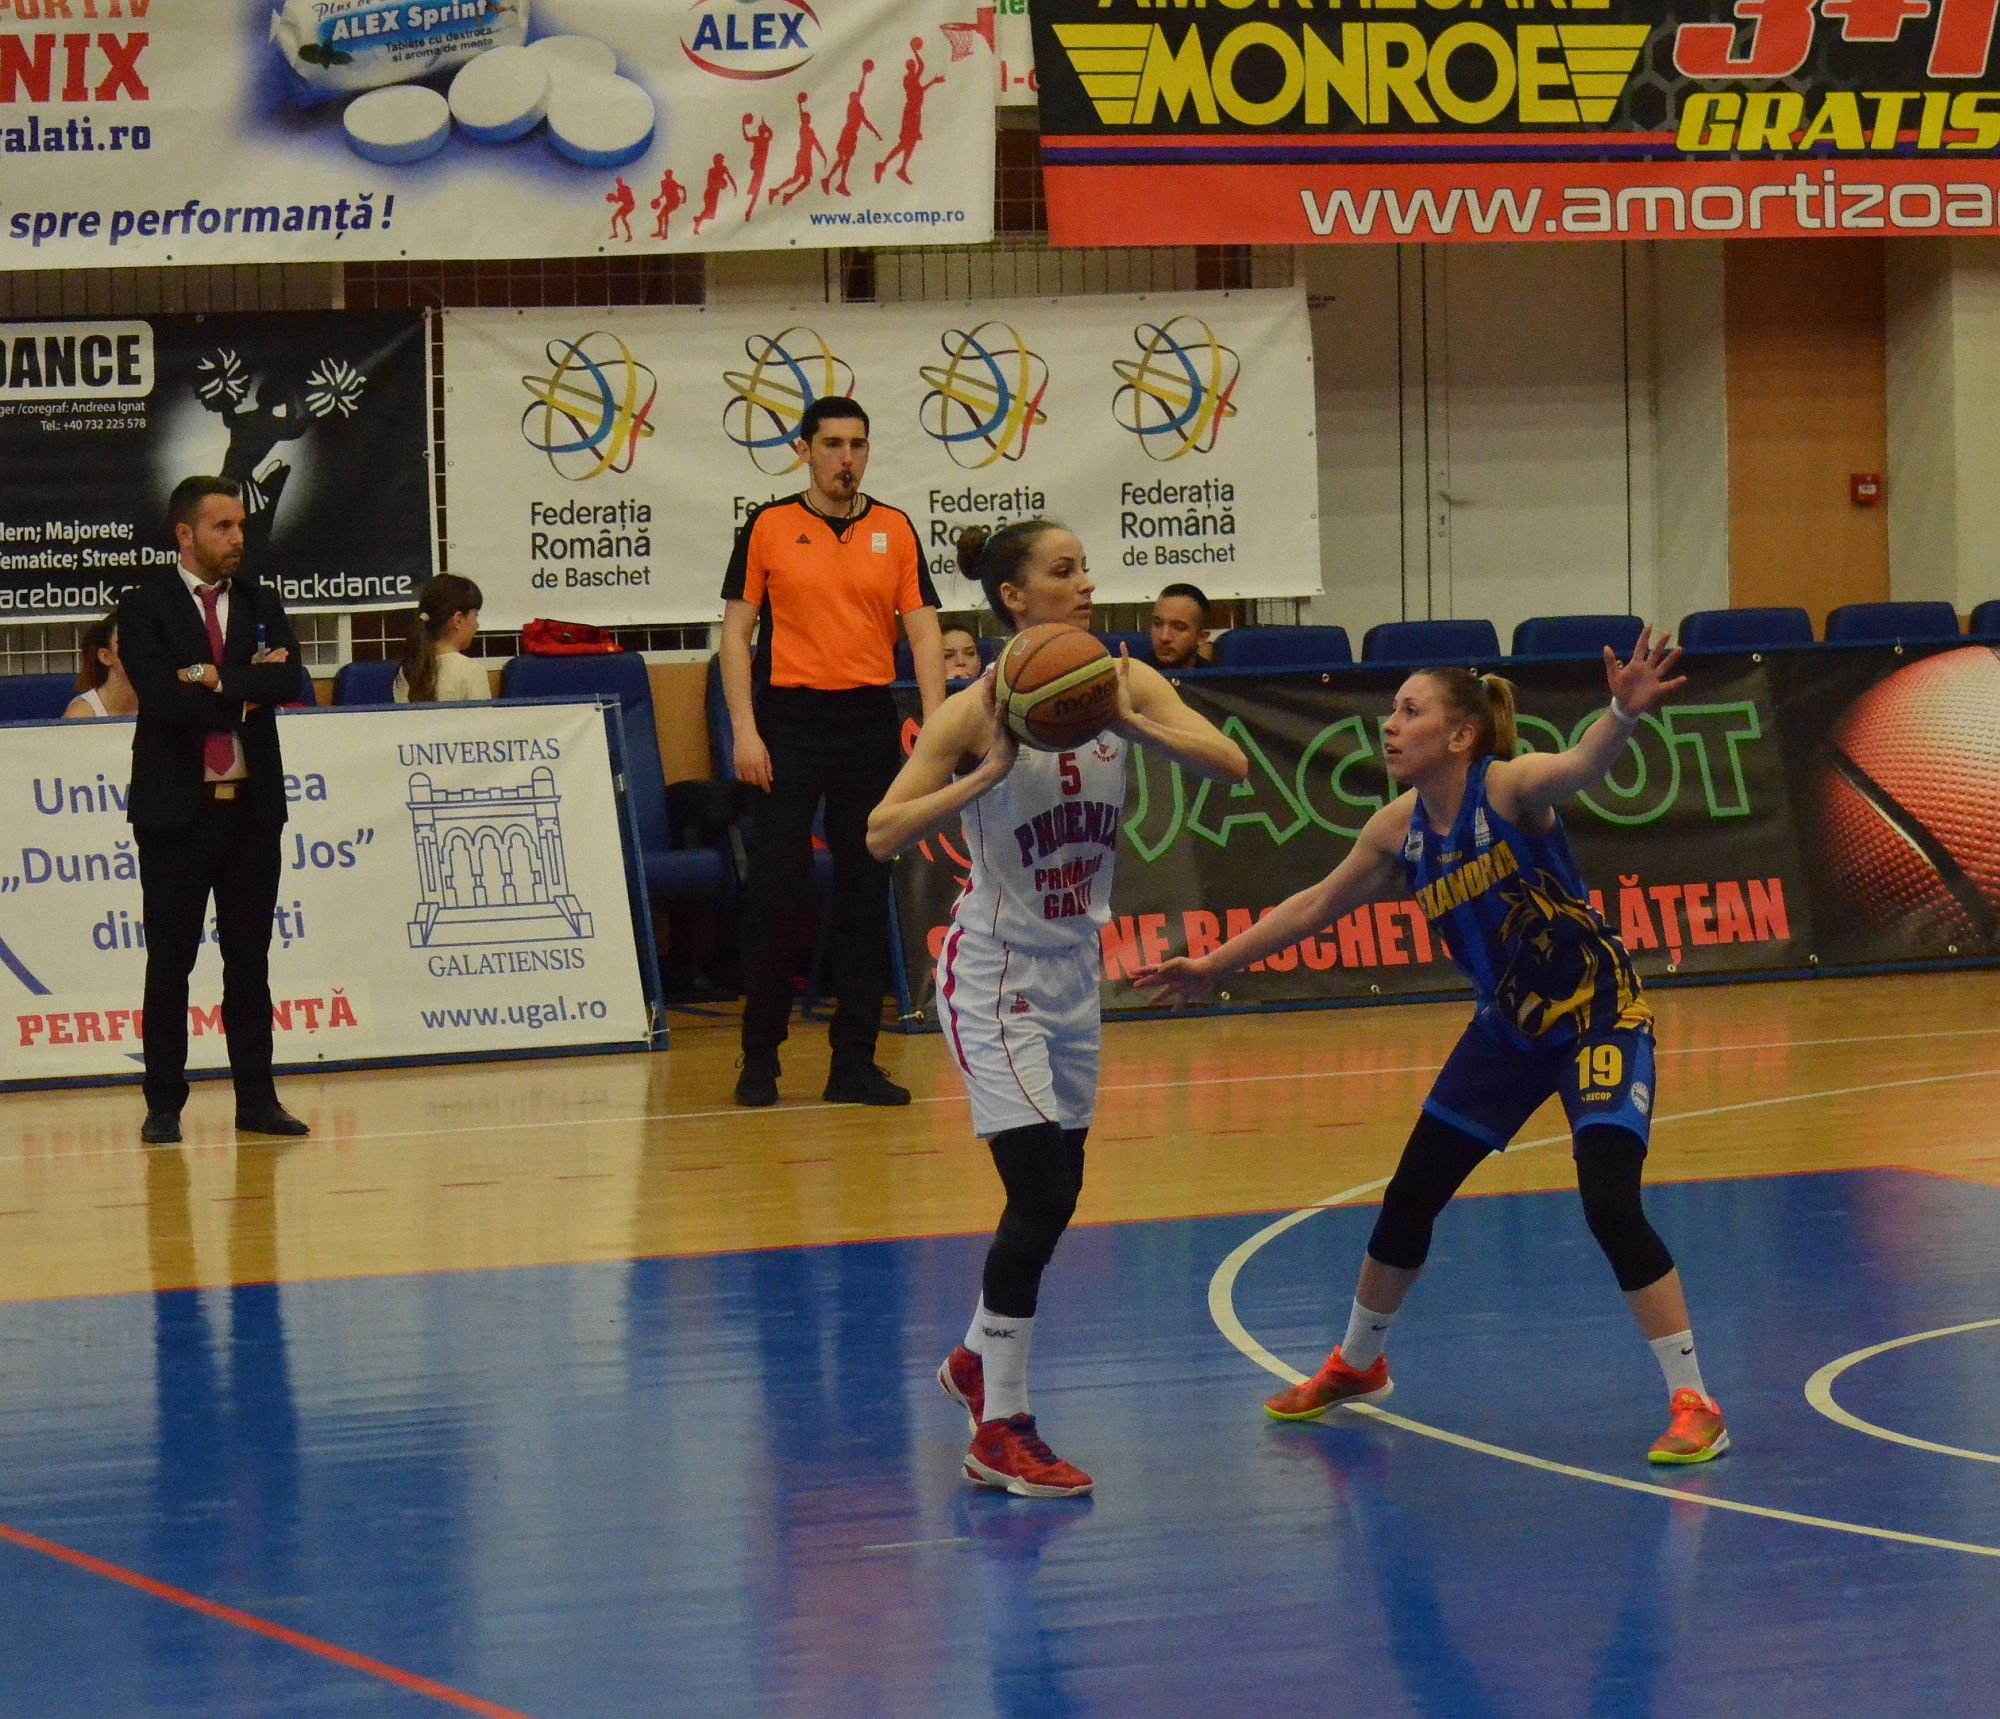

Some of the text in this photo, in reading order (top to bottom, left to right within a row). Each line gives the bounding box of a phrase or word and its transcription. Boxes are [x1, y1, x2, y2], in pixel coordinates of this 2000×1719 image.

[331, 0, 487, 41] ALEX Sprint
[692, 13, 809, 51] ALEX
[391, 37, 494, 62] si aroma de menta
[428, 36, 443, 46] cu
[1129, 21, 1582, 126] MONROE
[0, 115, 151, 153] alati.ro
[1675, 91, 2000, 152] GRATIS
[809, 208, 966, 226] www.alexcomp.ro
[1299, 168, 2000, 236] www.amortizoa
[9, 207, 100, 248] spre
[63, 420, 83, 430] +40
[85, 419, 104, 430] 732
[106, 418, 125, 429] 225
[127, 418, 147, 429] 578
[71, 401, 116, 414] Andreea
[117, 401, 146, 415] Ignat
[929, 485, 1046, 518] Federația
[1120, 478, 1235, 510] Federația
[531, 499, 652, 530] Federația
[1120, 506, 1236, 540] Română
[46, 520, 134, 545] Majorete;
[531, 527, 652, 561] Română
[0, 547, 182, 570] ematice; Street Dan
[930, 555, 956, 576] de
[1122, 542, 1236, 566] de Baschet
[531, 565, 652, 589] de Baschet
[398, 738, 561, 767] UNIVERSITAS
[1058, 752, 1082, 796] 5
[427, 948, 585, 977] GALATIENSIS
[420, 996, 607, 1030] www.ugal.ro
[1574, 1044, 1623, 1091] 19
